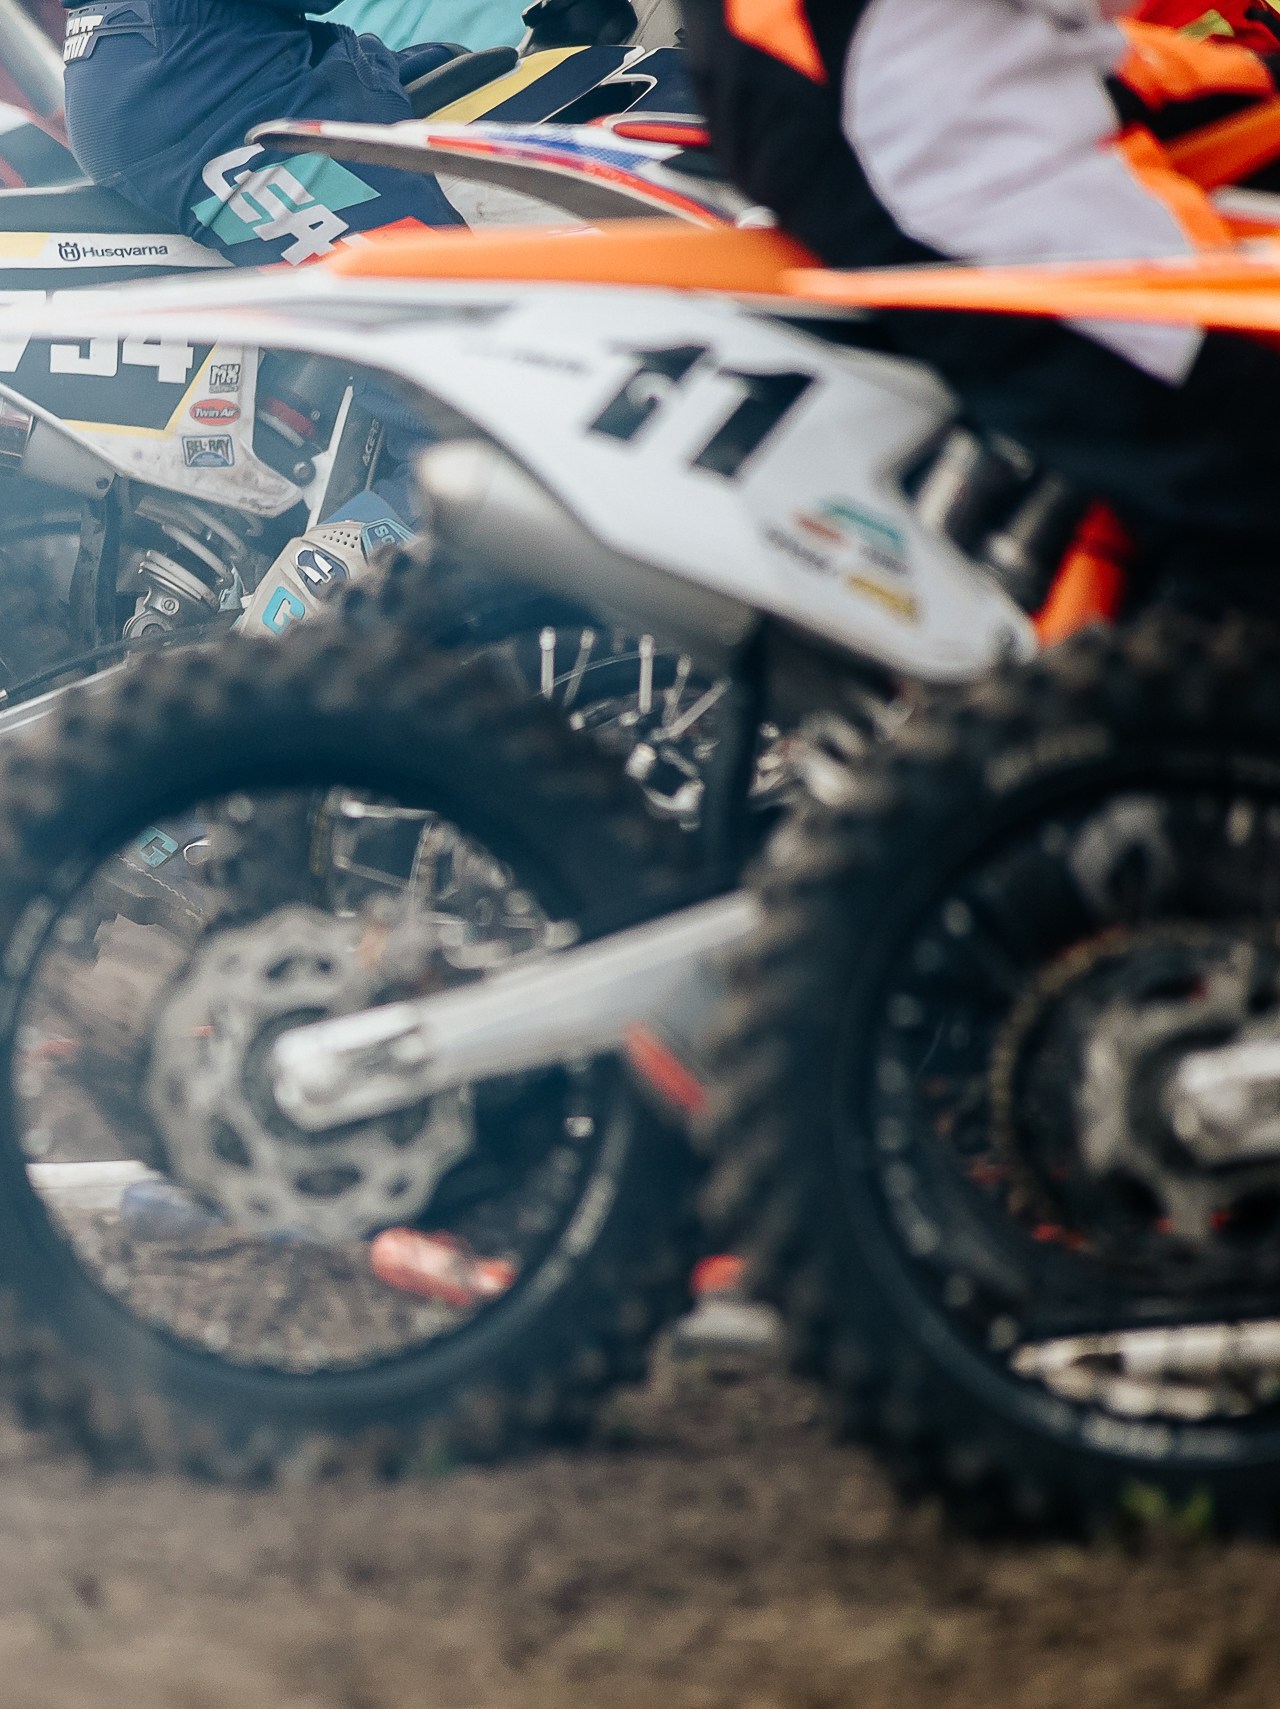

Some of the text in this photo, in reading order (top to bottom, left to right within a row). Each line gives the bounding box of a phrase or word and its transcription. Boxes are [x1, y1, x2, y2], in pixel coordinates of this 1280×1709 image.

[202, 142, 372, 267] LEA
[82, 245, 169, 258] Husqvarna
[209, 364, 241, 386] MX
[194, 407, 237, 419] Twin Air
